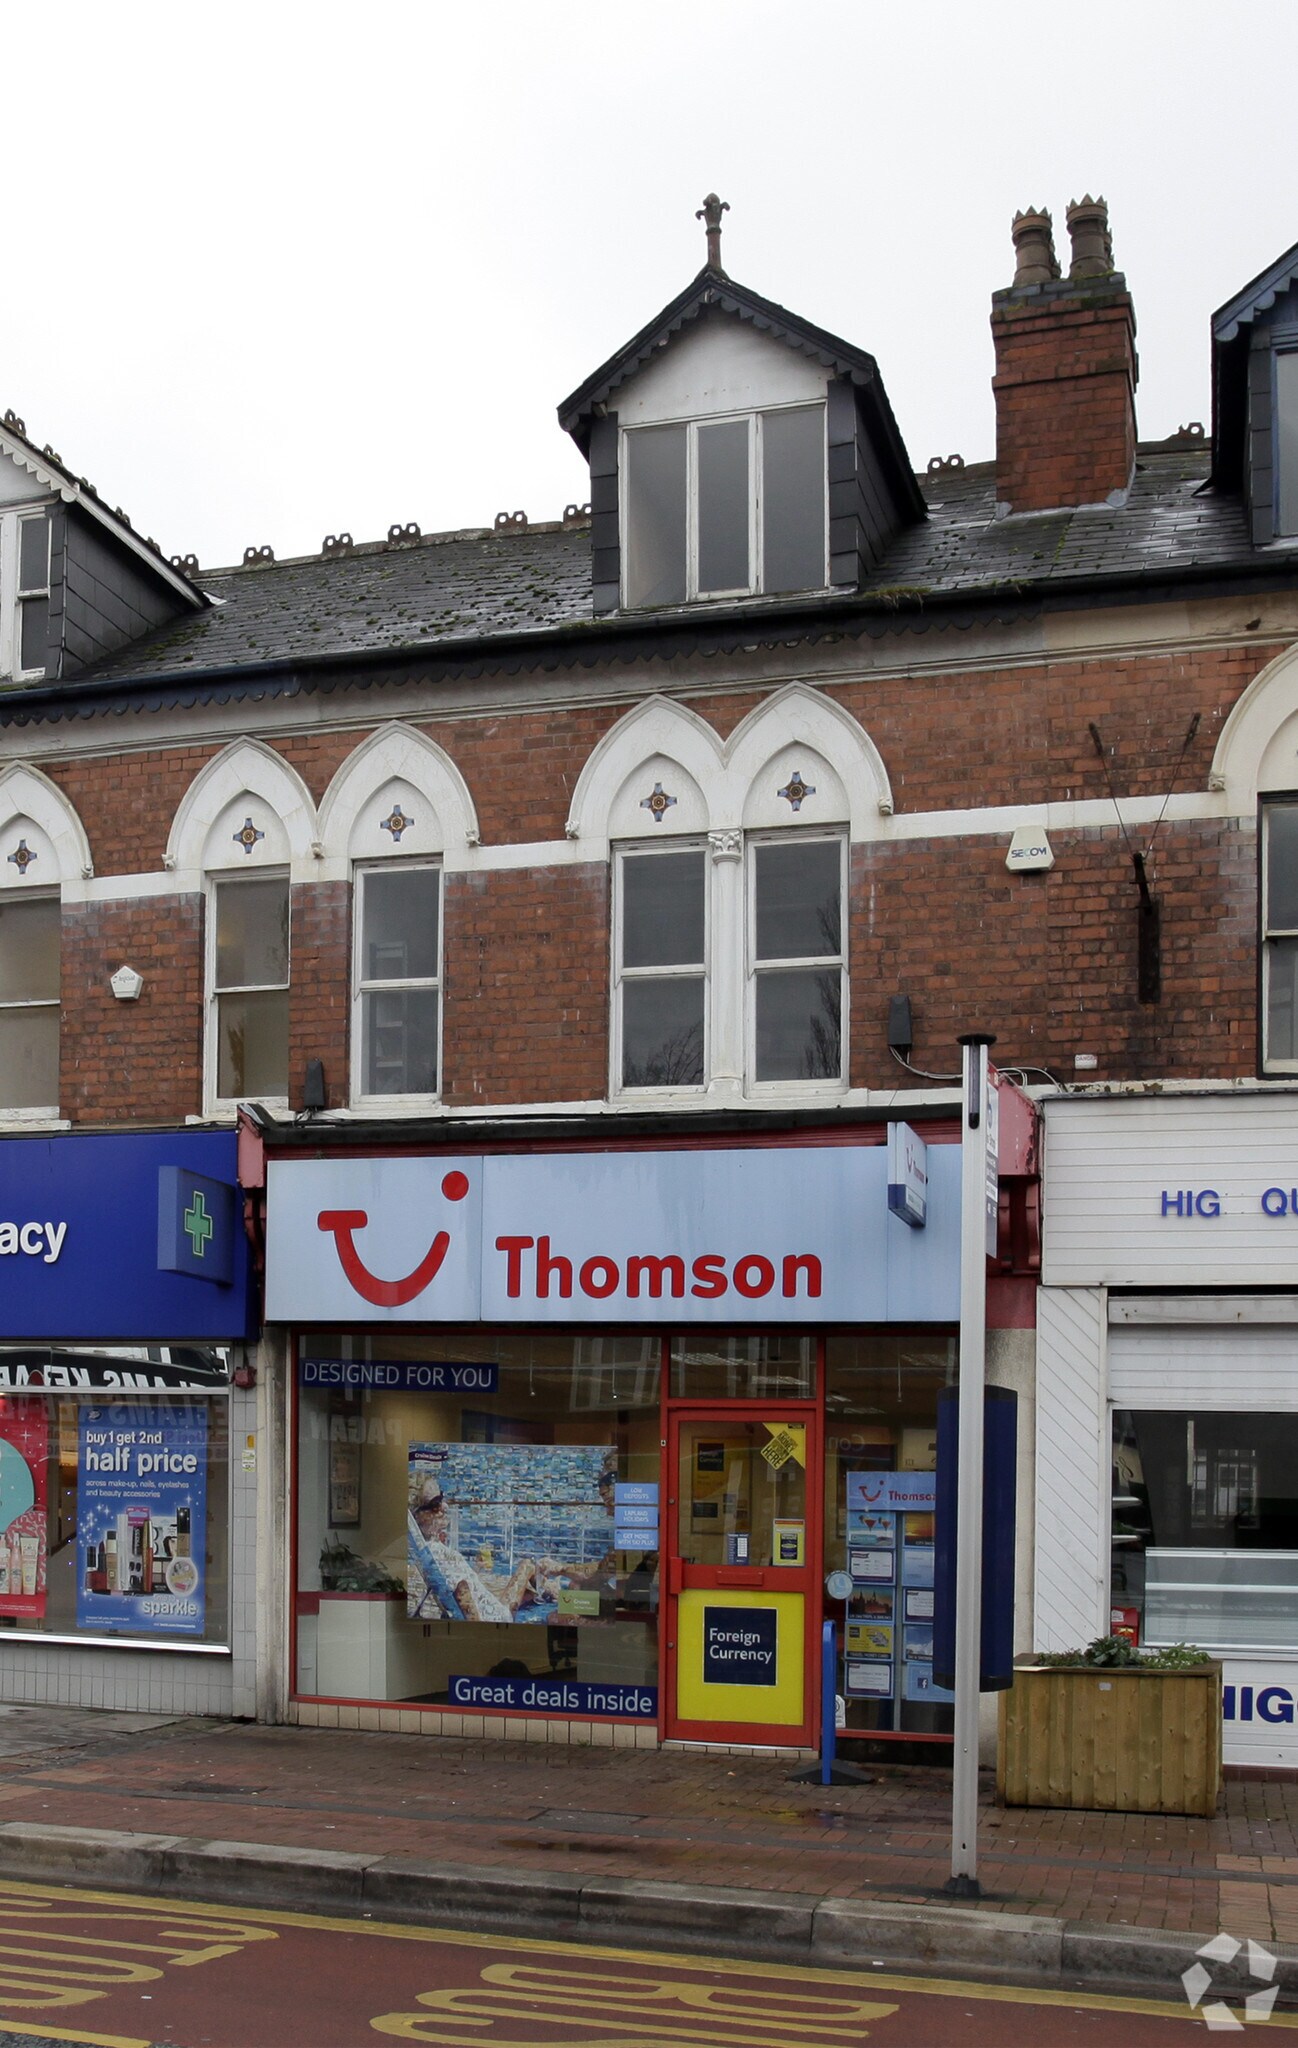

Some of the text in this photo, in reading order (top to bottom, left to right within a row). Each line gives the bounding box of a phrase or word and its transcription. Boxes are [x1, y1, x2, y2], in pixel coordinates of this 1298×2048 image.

[1011, 846, 1047, 859] SECOM
[1161, 1189, 1221, 1218] HIG
[495, 1235, 823, 1300] Thomson
[303, 1362, 493, 1389] DESIGNED FOR YOU
[86, 1430, 107, 1447] buy
[109, 1431, 114, 1444] 1
[116, 1431, 137, 1447] get
[138, 1430, 163, 1445] 2nd
[85, 1446, 198, 1478] half price
[85, 1480, 107, 1488] across
[158, 1480, 190, 1490] eyelashes
[85, 1489, 98, 1497] and
[99, 1489, 121, 1499] beauty
[887, 1489, 935, 1503] Thomso
[142, 1598, 199, 1617] sparkle
[708, 1628, 761, 1648] Foreign
[708, 1645, 773, 1665] Currency
[454, 1677, 653, 1714] Great deals inside
